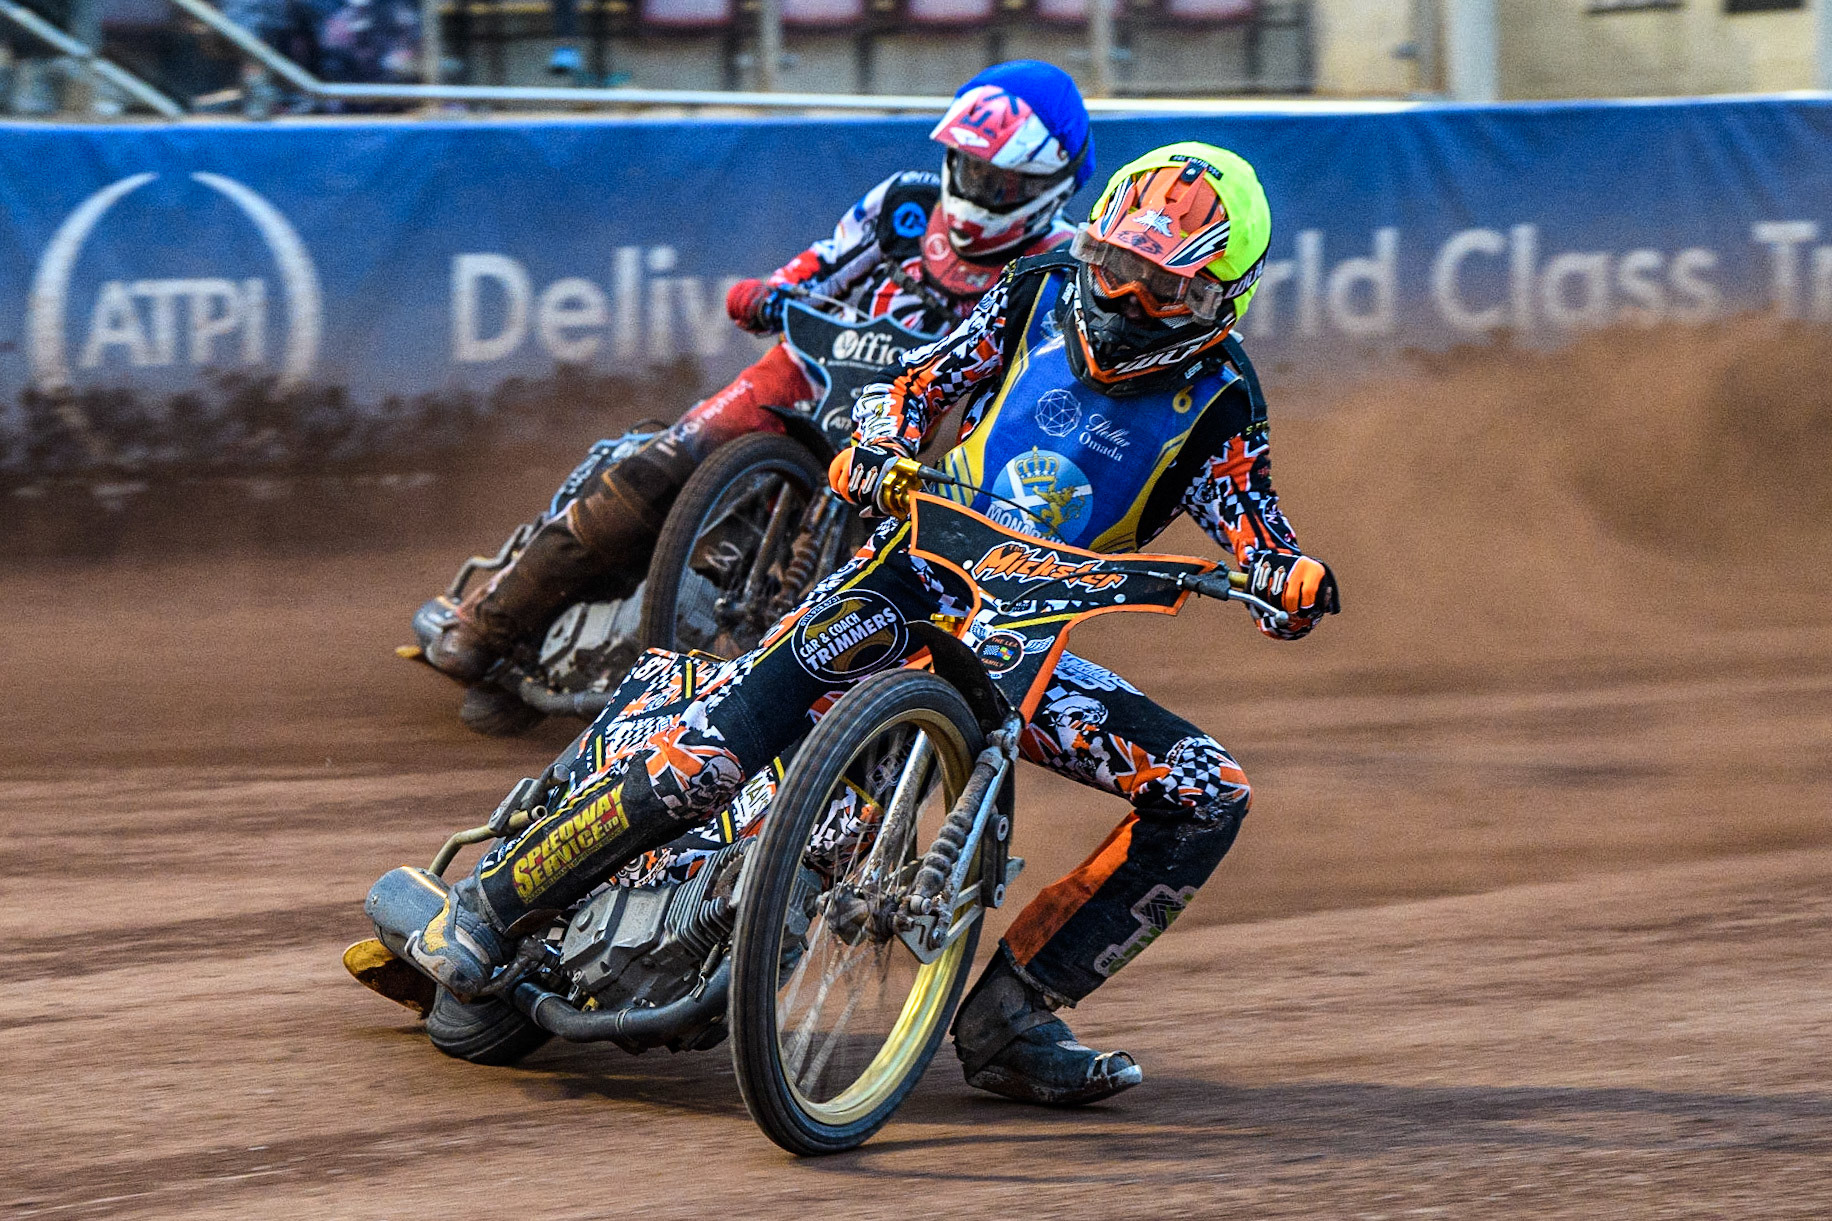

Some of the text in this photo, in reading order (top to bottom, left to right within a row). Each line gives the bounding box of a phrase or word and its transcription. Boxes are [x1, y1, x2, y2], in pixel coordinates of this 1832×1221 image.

[1431, 221, 1719, 333] Class
[79, 275, 269, 368] ATPI
[1172, 385, 1194, 414] 6
[1079, 431, 1123, 461] Omada
[1085, 413, 1130, 447] Stellar
[799, 612, 861, 658] CAR & COACH
[805, 607, 897, 671] TRIMMERS
[514, 820, 607, 898] SERVICE
[603, 815, 619, 832] LTD
